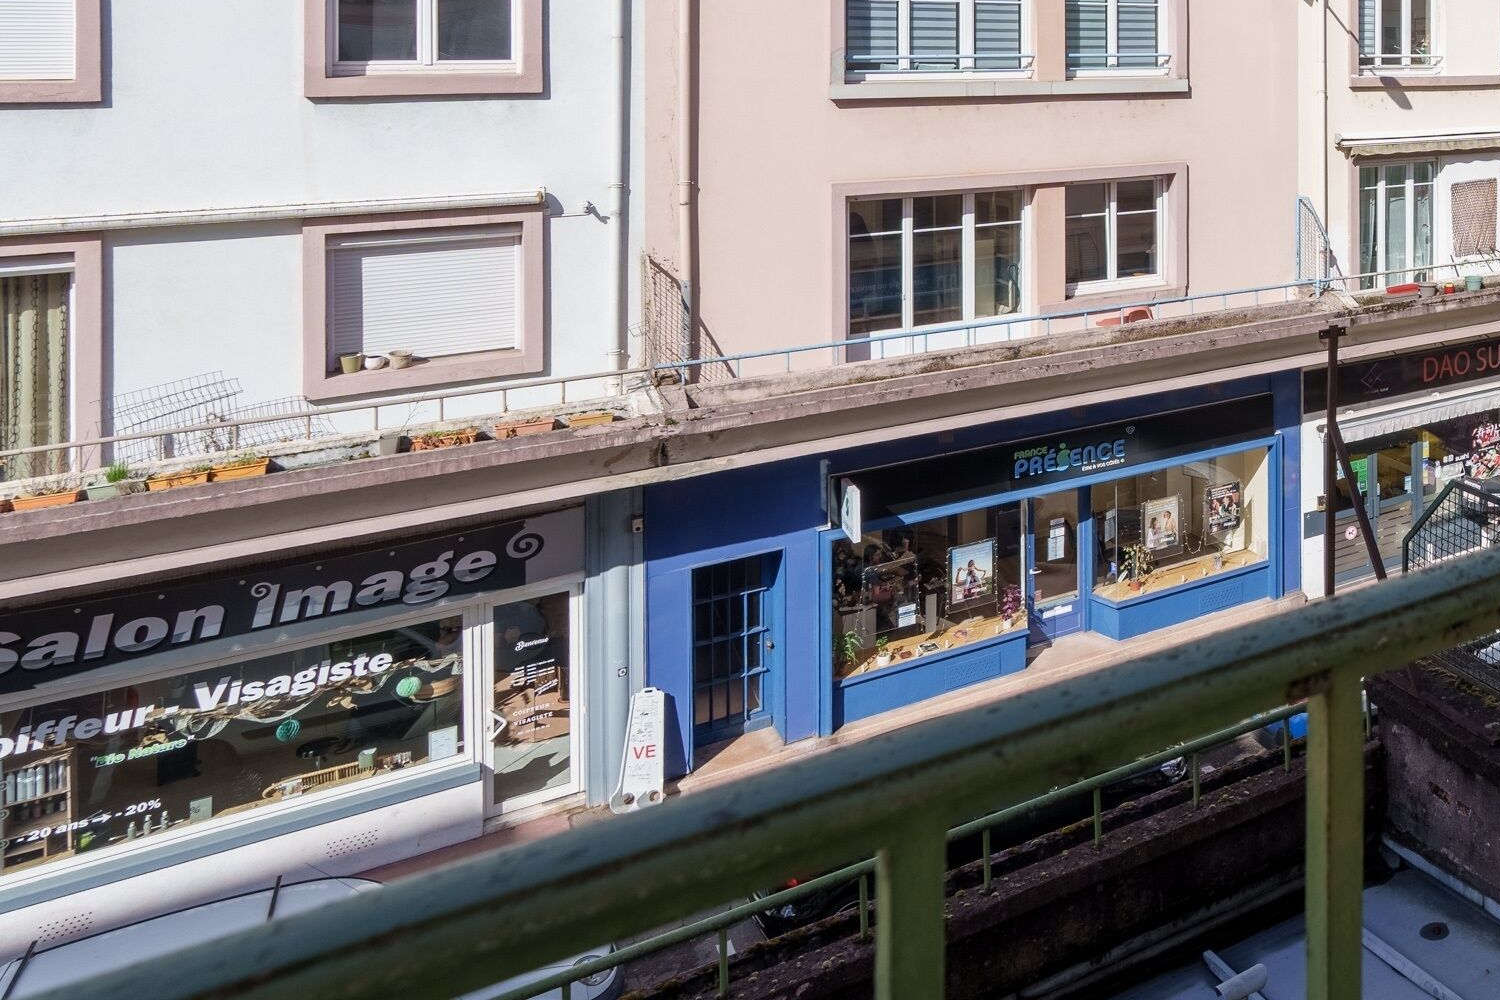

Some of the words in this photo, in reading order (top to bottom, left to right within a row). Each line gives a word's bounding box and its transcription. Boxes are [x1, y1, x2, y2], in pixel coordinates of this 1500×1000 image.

[1423, 351, 1470, 382] DAO
[1014, 446, 1048, 460] FRANCE
[251, 550, 497, 628] Image
[193, 653, 392, 712] Visagiste
[512, 703, 551, 717] COIFFEUR
[513, 711, 554, 726] VISAGISTE
[633, 744, 657, 760] VE
[56, 818, 89, 836] ans
